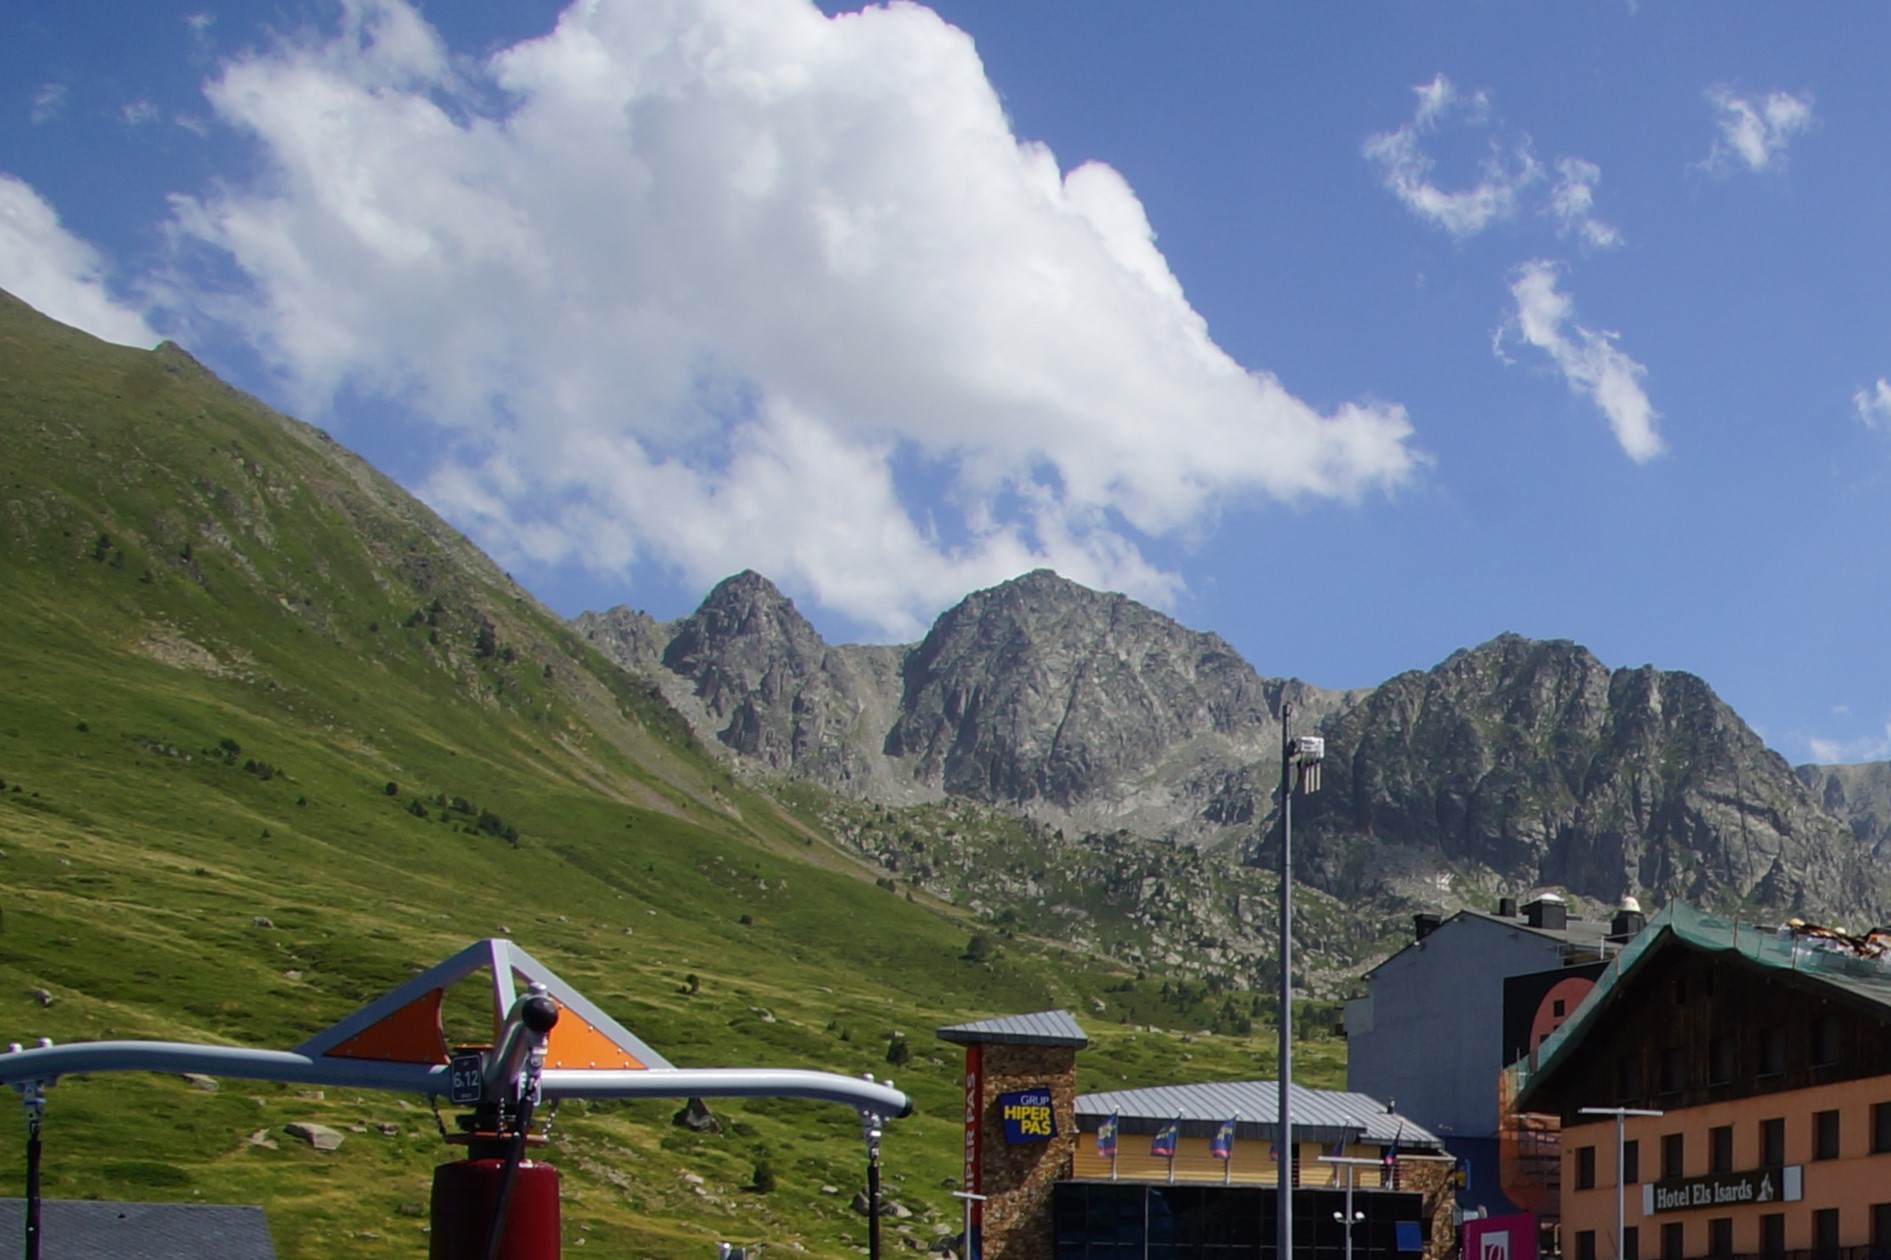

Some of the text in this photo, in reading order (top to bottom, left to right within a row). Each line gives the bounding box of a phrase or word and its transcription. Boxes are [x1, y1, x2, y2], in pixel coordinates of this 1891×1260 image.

[455, 1070, 479, 1089] 6.12
[966, 1072, 976, 1123] PAS
[1020, 1095, 1050, 1106] GRUP
[1004, 1105, 1051, 1120] HIPER
[1021, 1119, 1052, 1135] PAS
[1657, 1178, 1753, 1209] Hotel Els Isards
